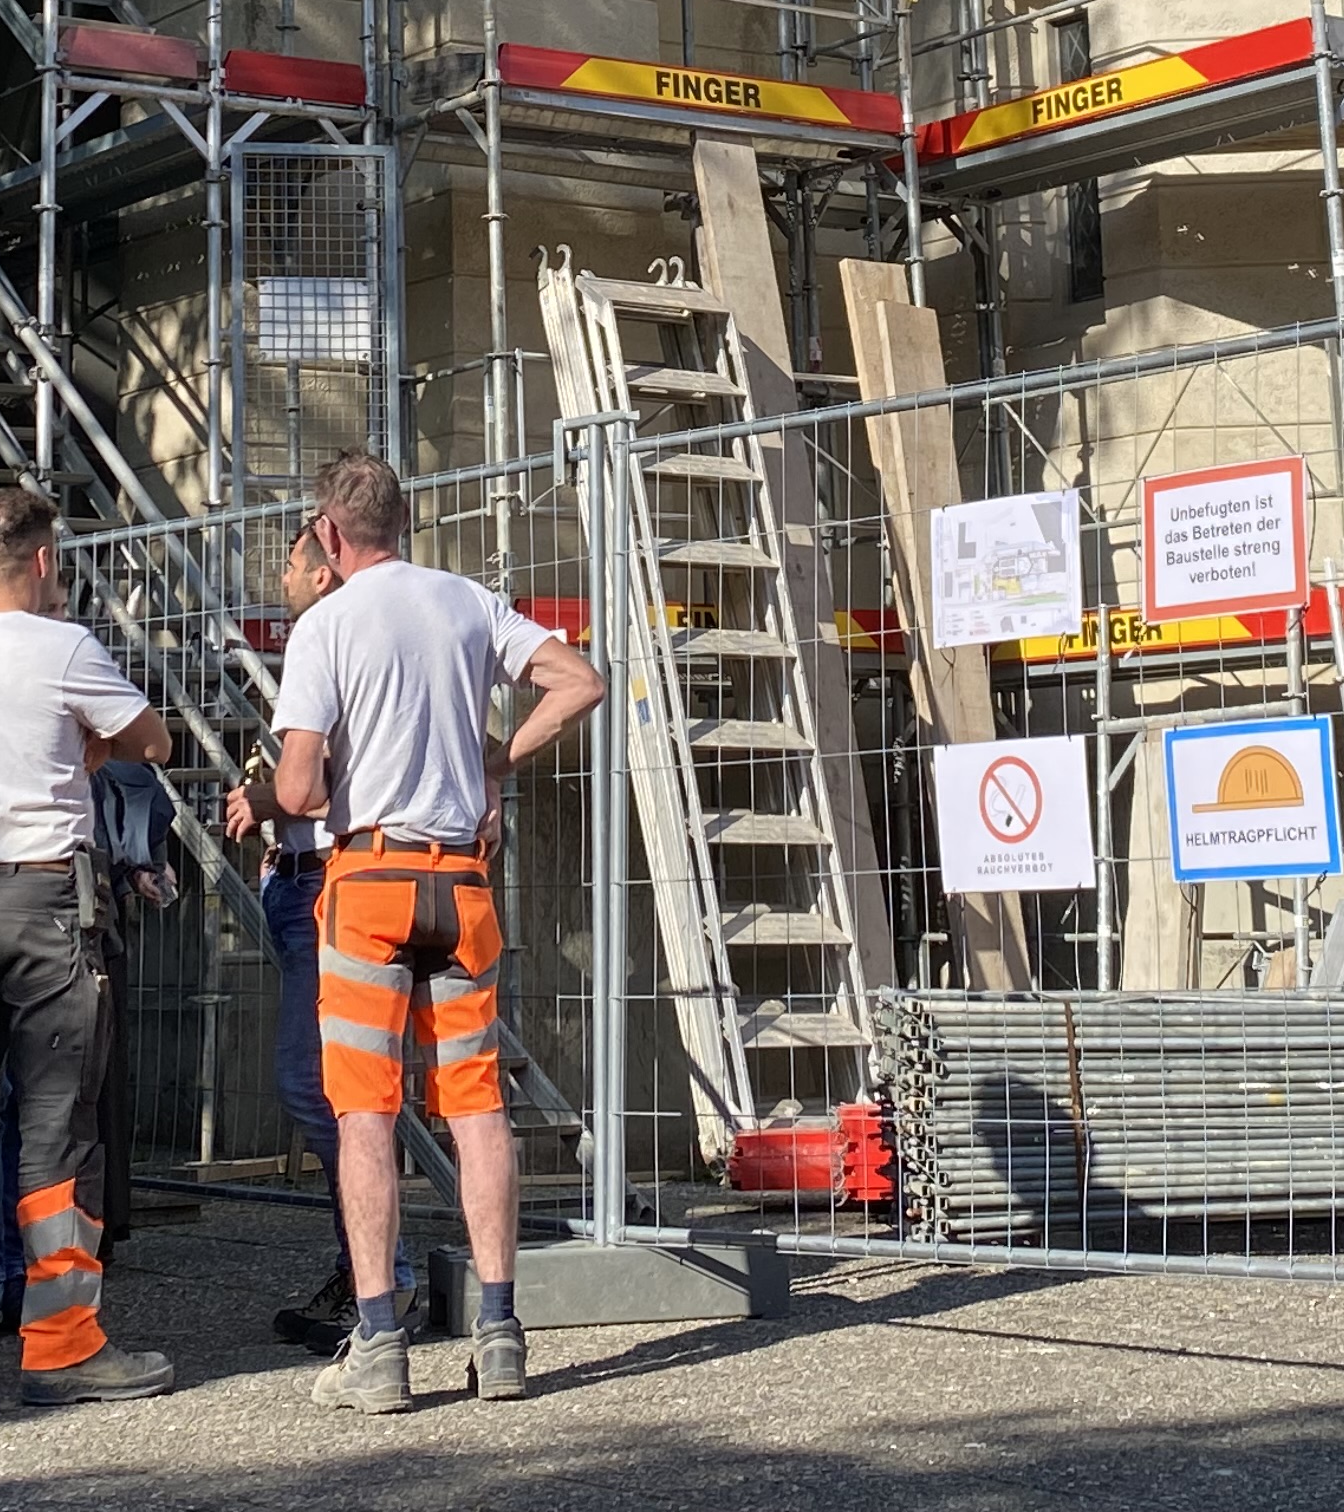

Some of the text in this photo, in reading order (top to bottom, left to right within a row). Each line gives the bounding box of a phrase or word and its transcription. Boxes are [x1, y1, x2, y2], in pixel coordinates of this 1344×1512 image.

[655, 70, 763, 110] FINGER
[1031, 76, 1124, 123] FINGER
[1170, 495, 1273, 521] Unbefugten ist
[1164, 516, 1281, 544] das Betreten der
[1166, 540, 1281, 566] Baustelle streng
[1189, 562, 1256, 584] verboten!
[1186, 825, 1318, 848] HELMTRAGPFLICHT
